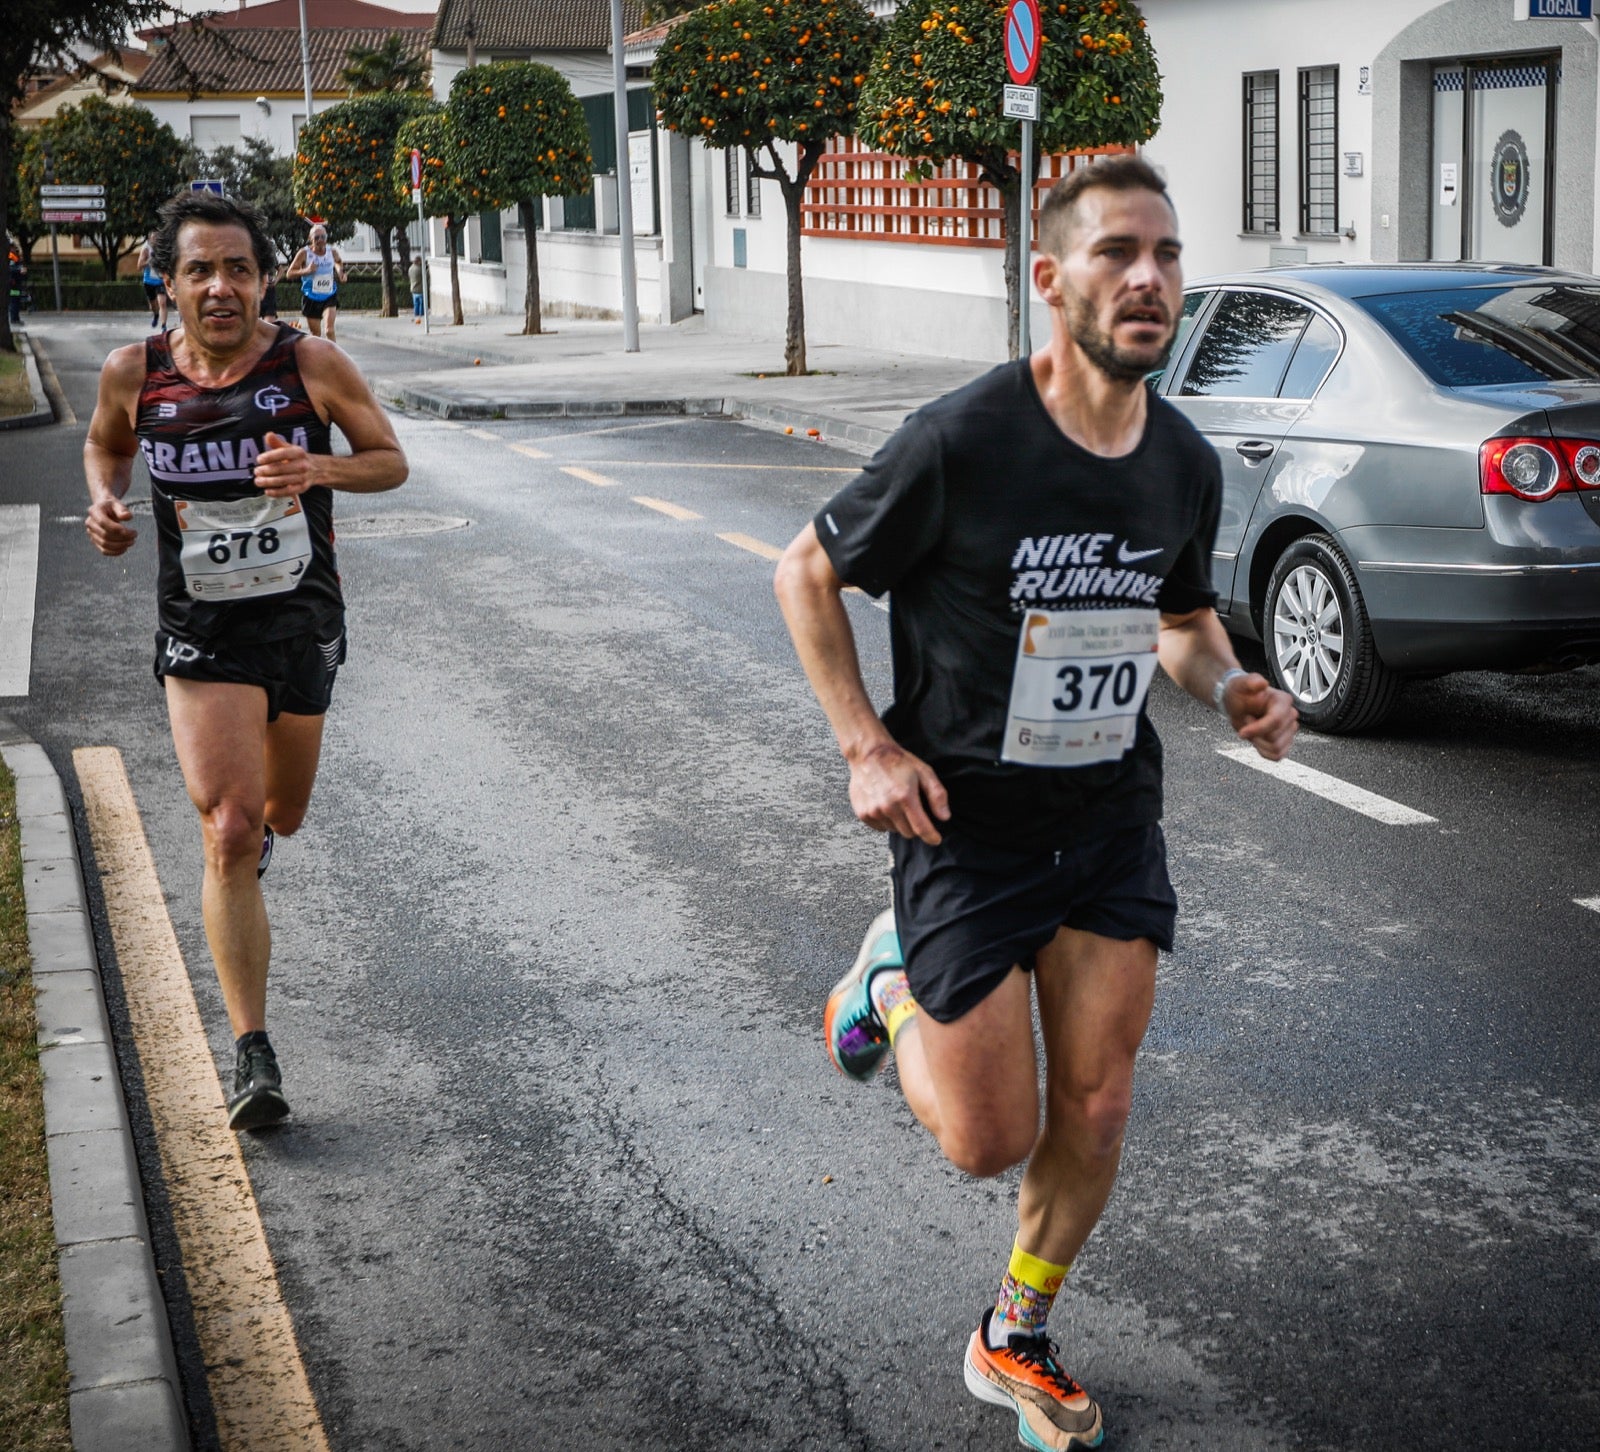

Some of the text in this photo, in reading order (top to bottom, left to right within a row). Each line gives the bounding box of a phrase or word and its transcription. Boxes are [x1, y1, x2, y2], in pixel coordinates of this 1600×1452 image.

[1538, 0, 1582, 15] LOCAL
[140, 427, 308, 473] GRANAA
[208, 527, 280, 564] 678
[1011, 533, 1114, 569] NIKE
[1052, 660, 1137, 712] 370
